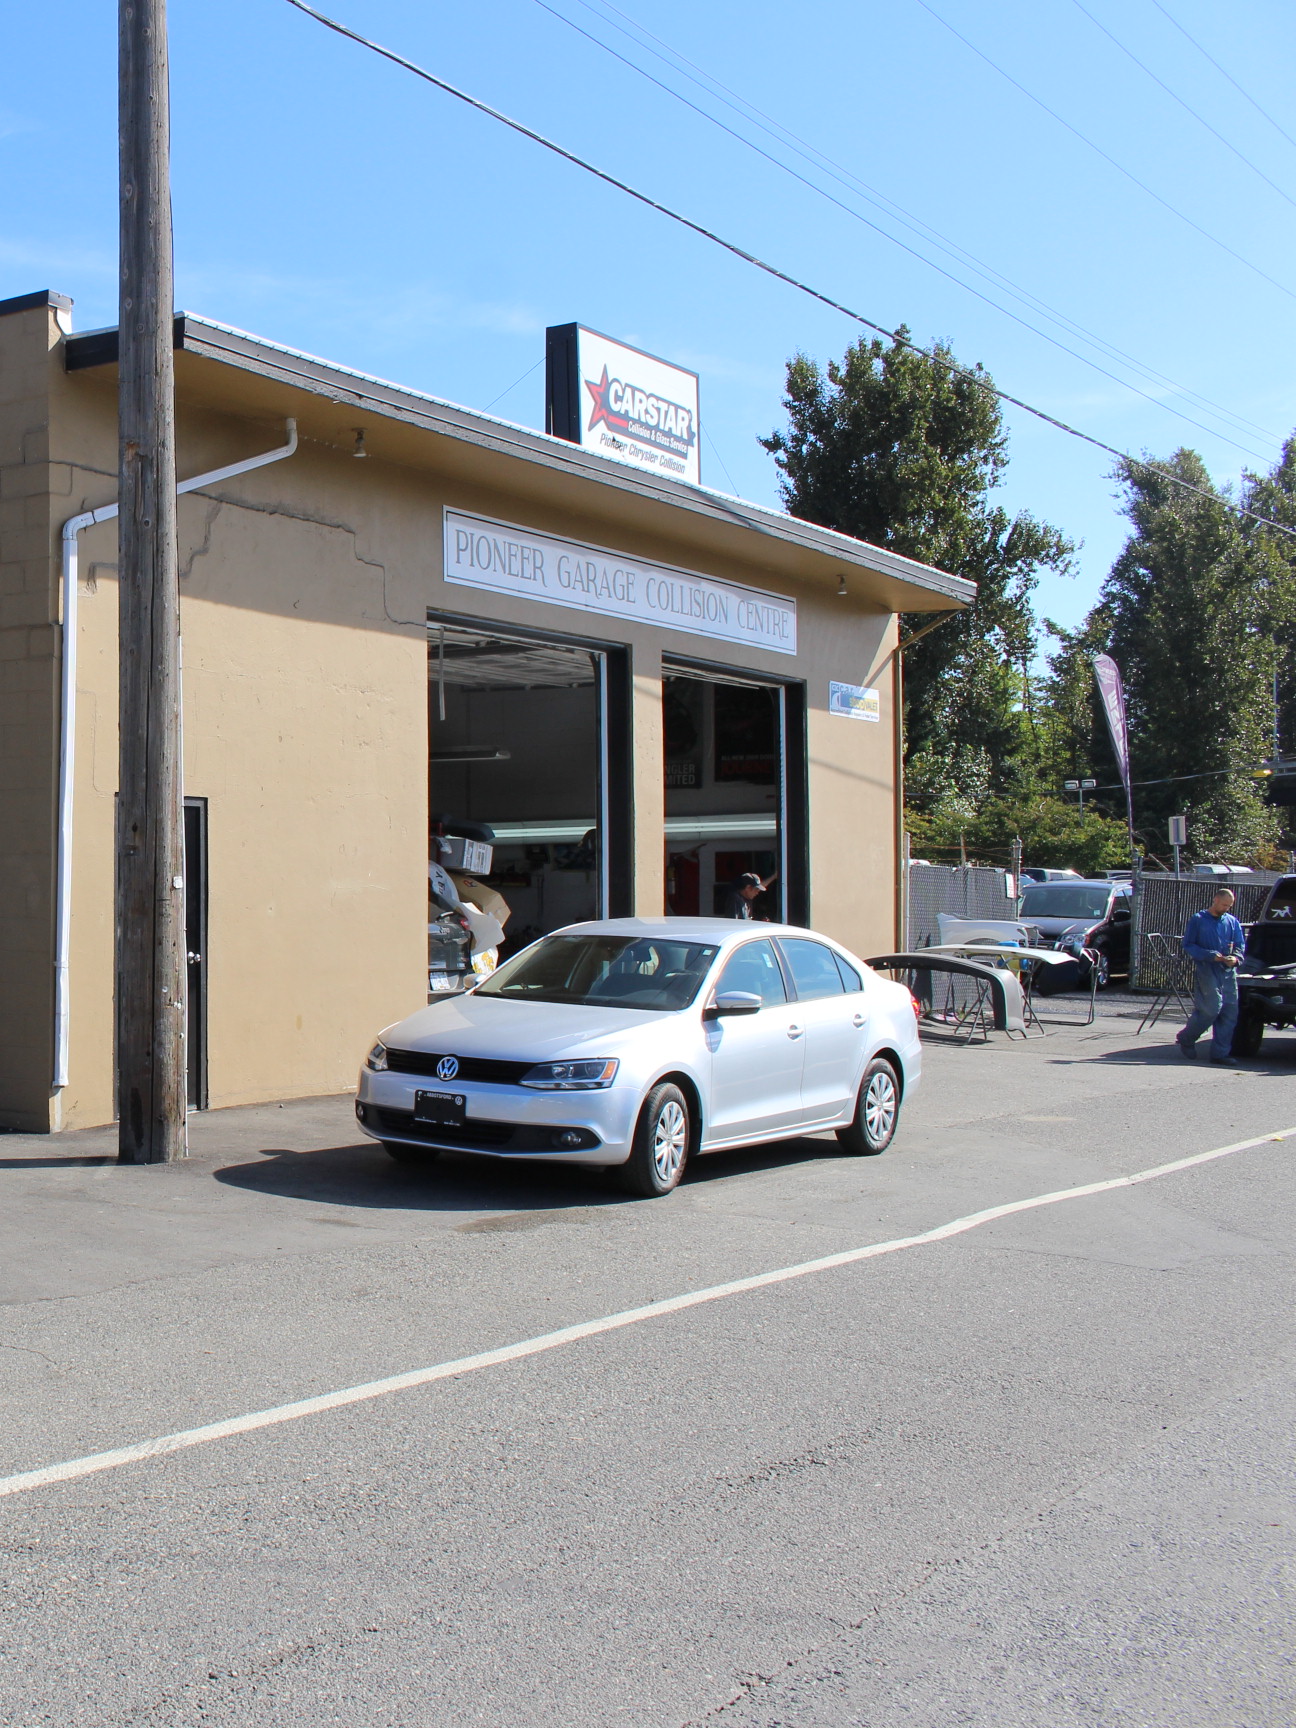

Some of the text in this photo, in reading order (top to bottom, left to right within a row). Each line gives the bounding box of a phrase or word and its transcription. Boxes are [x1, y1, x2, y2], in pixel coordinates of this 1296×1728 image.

[608, 379, 690, 440] CARSTAR
[599, 432, 686, 474] Pioneer Chrysler Collision
[627, 420, 651, 439] Collision
[656, 431, 670, 448] Glass
[670, 435, 688, 454] Service
[455, 528, 790, 641] PIONEER GARAGE COLLISION CENTRE
